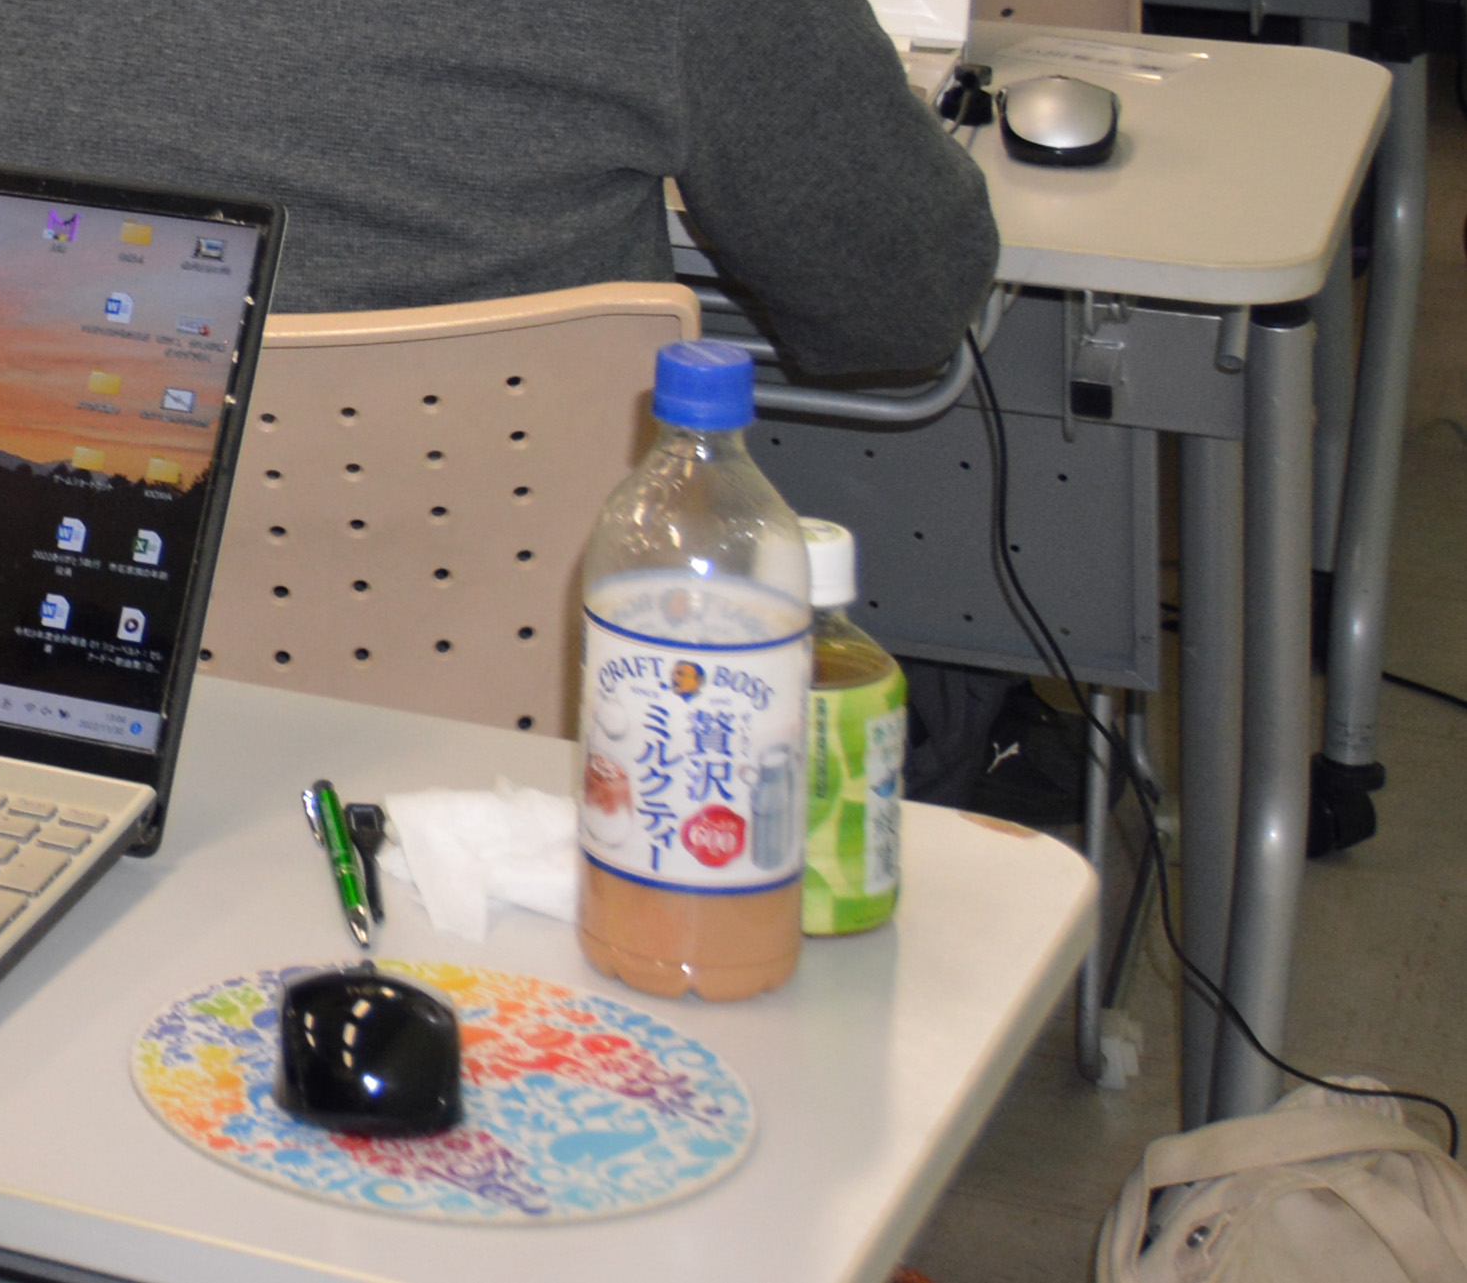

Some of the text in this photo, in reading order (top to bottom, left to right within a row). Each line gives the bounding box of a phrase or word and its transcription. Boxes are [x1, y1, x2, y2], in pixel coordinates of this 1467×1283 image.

[599, 655, 775, 711] CRAFT BOSS
[634, 702, 685, 873] ミルクティー
[685, 709, 735, 803] 贅沢
